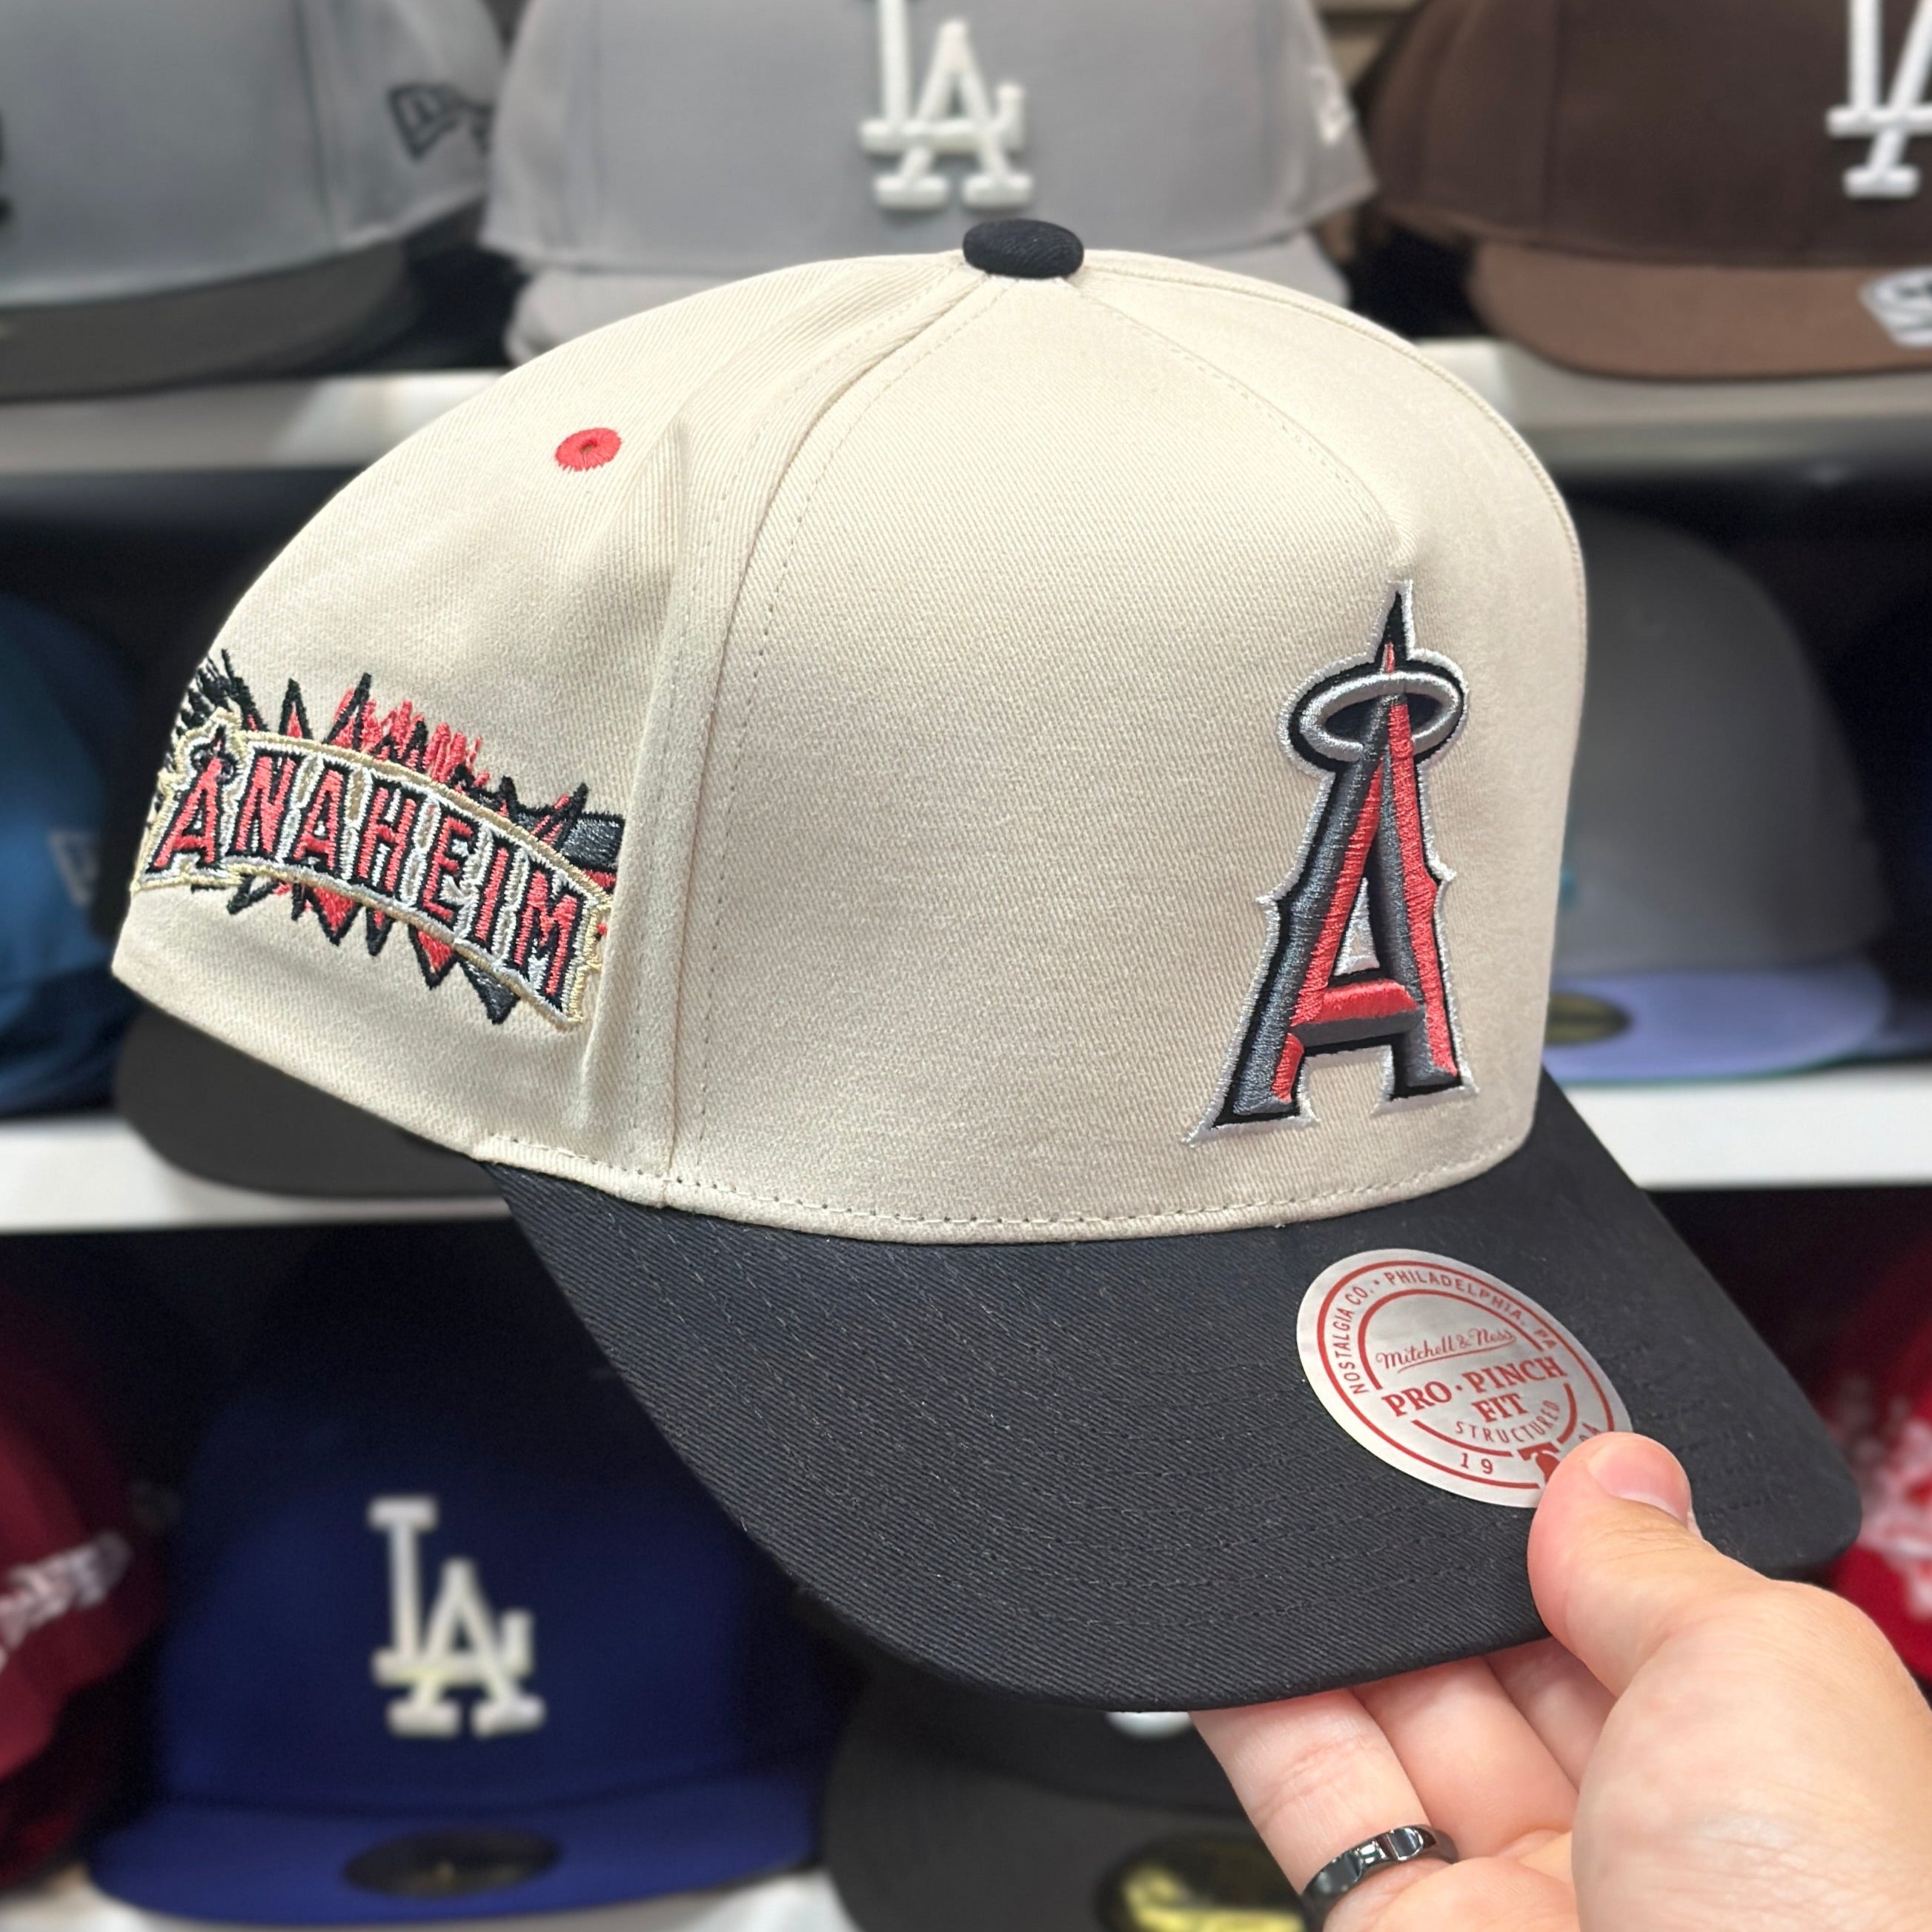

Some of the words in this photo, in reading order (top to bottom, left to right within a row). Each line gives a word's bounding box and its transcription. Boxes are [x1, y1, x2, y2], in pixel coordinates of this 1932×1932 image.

[860, 0, 1033, 209] LA
[145, 723, 587, 1014] ANAHEIM
[1186, 580, 1479, 1145] A
[1332, 1307, 1370, 1395] NOSTALGIA
[1375, 1335, 1455, 1370] Mitchell
[1455, 1334, 1472, 1348] &
[1469, 1328, 1513, 1347] Ness
[1381, 1381, 1453, 1417] PRO
[1461, 1355, 1568, 1393] PINCH
[1455, 1400, 1561, 1444] STRUCTURED
[1471, 1392, 1529, 1423] FIT
[369, 1496, 546, 1738] LA
